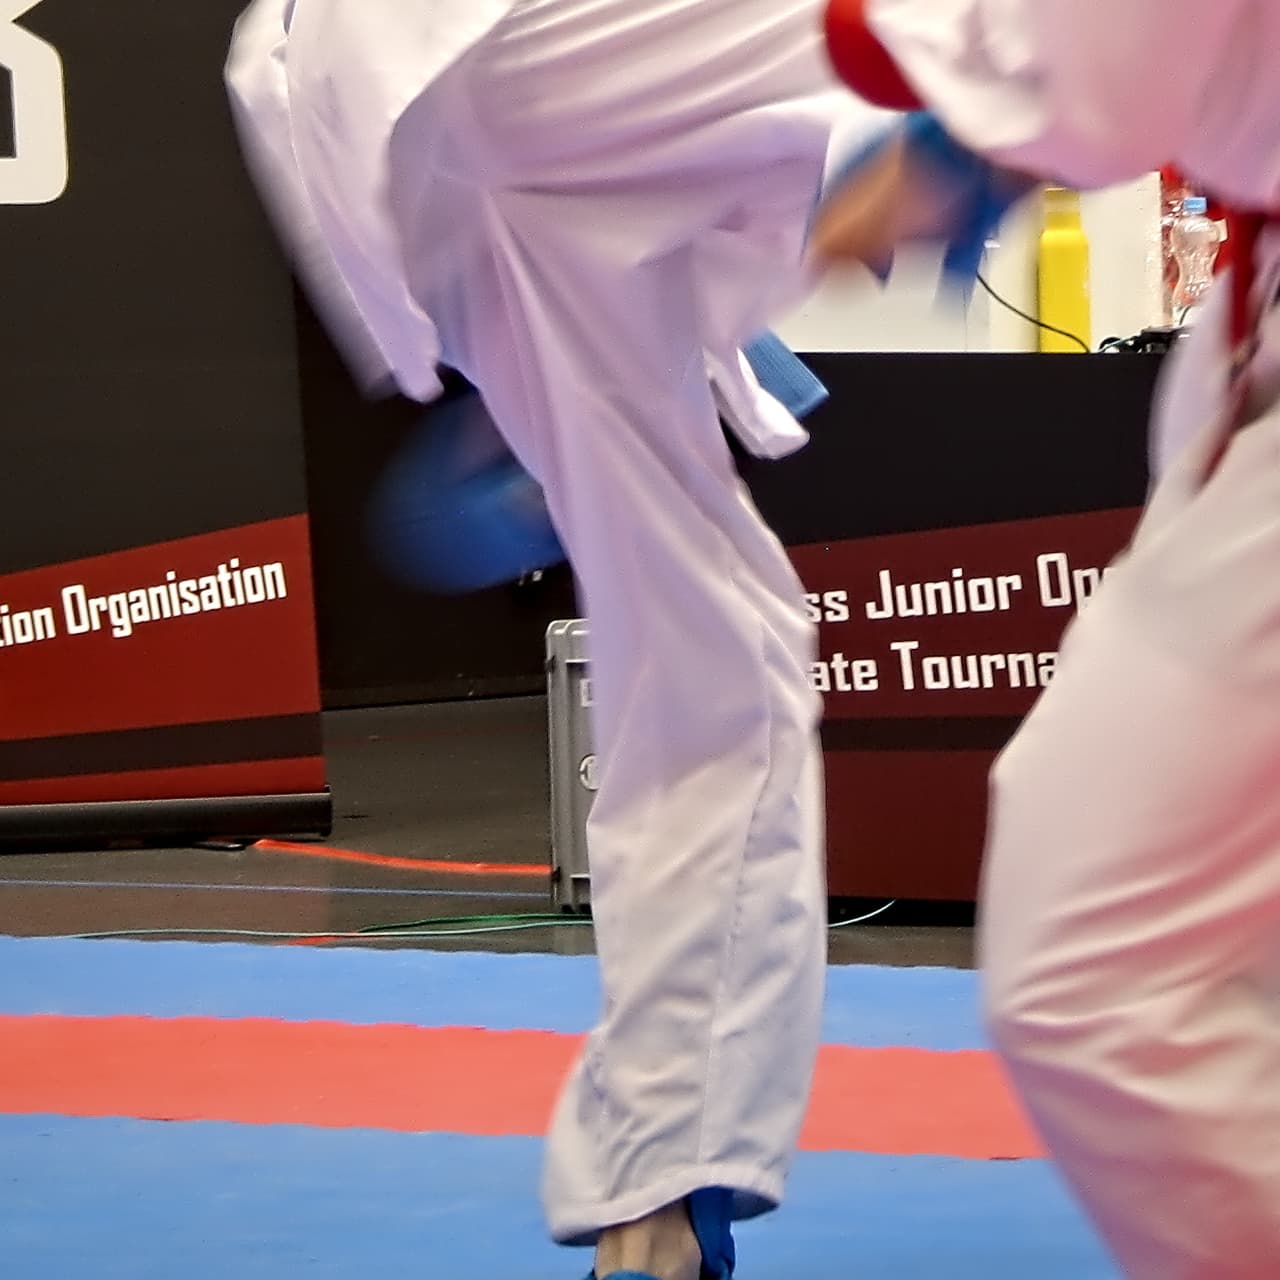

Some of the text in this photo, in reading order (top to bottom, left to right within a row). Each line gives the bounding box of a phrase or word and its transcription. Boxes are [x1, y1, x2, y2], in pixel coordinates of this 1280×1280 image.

[61, 558, 287, 638] Organisation
[865, 568, 1021, 620] Junior
[1036, 552, 1109, 616] Op
[890, 640, 1059, 690] Tourna
